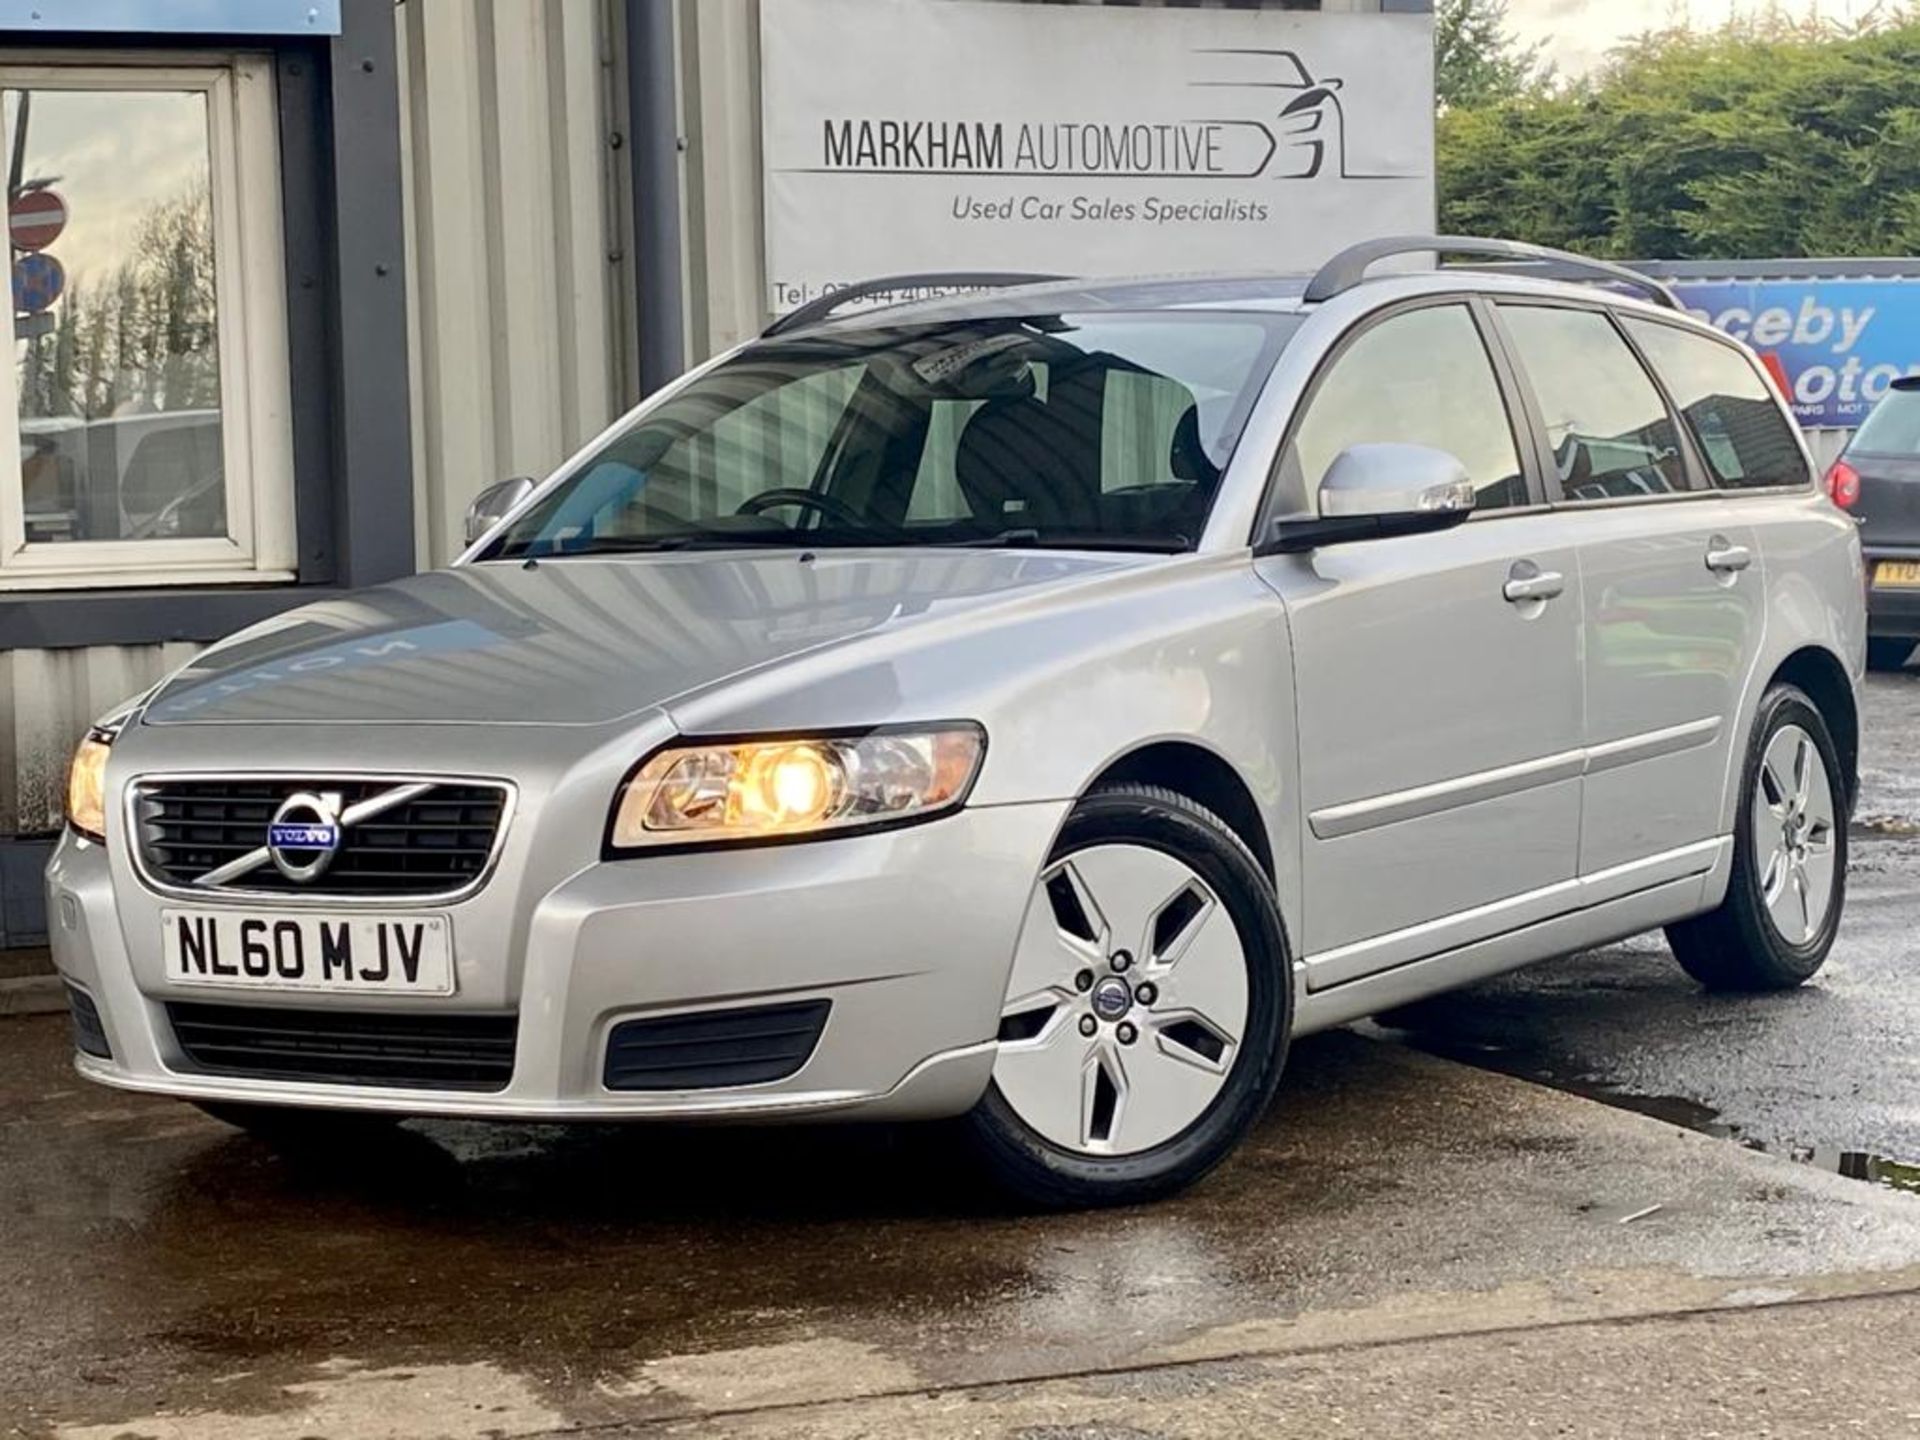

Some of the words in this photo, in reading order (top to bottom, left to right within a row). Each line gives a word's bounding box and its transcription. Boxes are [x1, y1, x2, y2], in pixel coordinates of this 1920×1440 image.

[824, 119, 1003, 169] MARKHAM
[1015, 123, 1224, 172] AUTOMOTIVE
[952, 195, 1014, 220] Used
[1020, 196, 1064, 221] Car
[1070, 196, 1135, 221] Sales
[1143, 197, 1268, 224] Specialists
[272, 828, 332, 843] VOLVO
[178, 916, 304, 979] NL60
[320, 921, 425, 983] MJV
